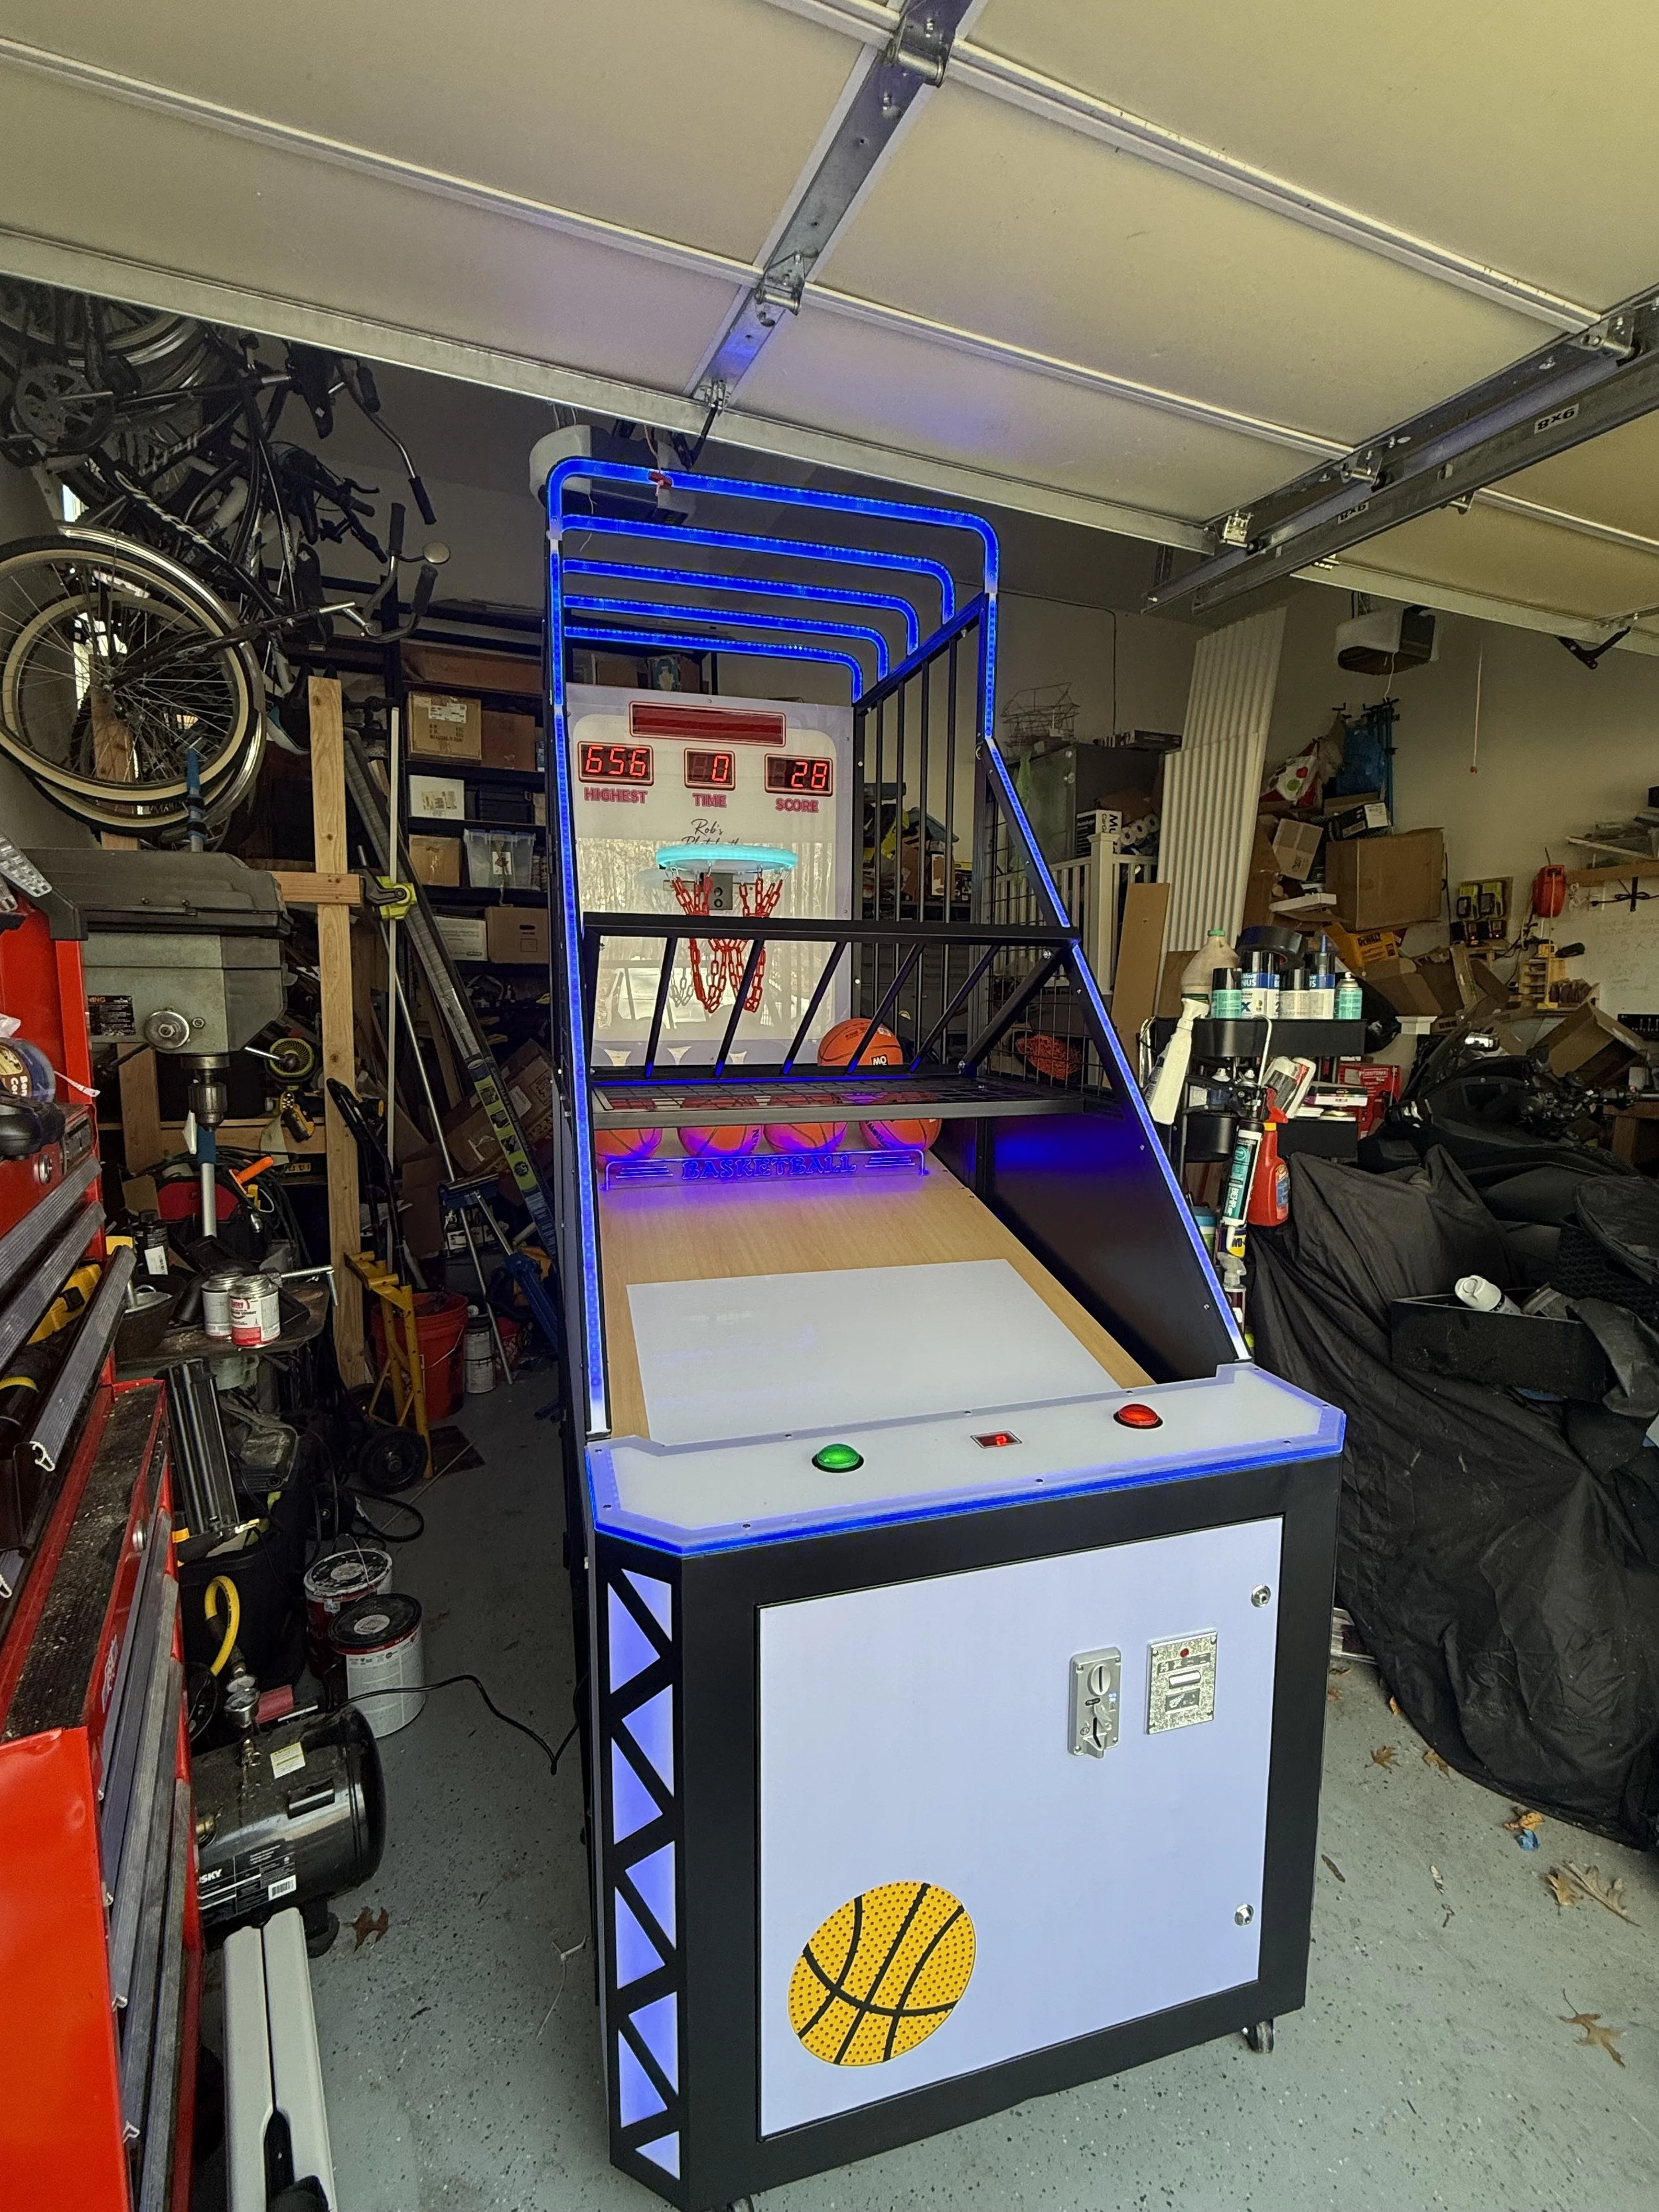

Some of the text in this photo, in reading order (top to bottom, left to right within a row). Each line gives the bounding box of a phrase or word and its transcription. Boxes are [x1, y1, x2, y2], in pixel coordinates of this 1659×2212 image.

[585, 745, 648, 777] 656
[790, 761, 828, 789] 28
[583, 786, 648, 804] HIGHEST
[692, 792, 727, 808] TIME
[774, 797, 820, 814] SCORE
[691, 818, 724, 836] Rob's
[682, 1155, 857, 1181] BASKETBALL
[199, 1868, 223, 1884] SKY
